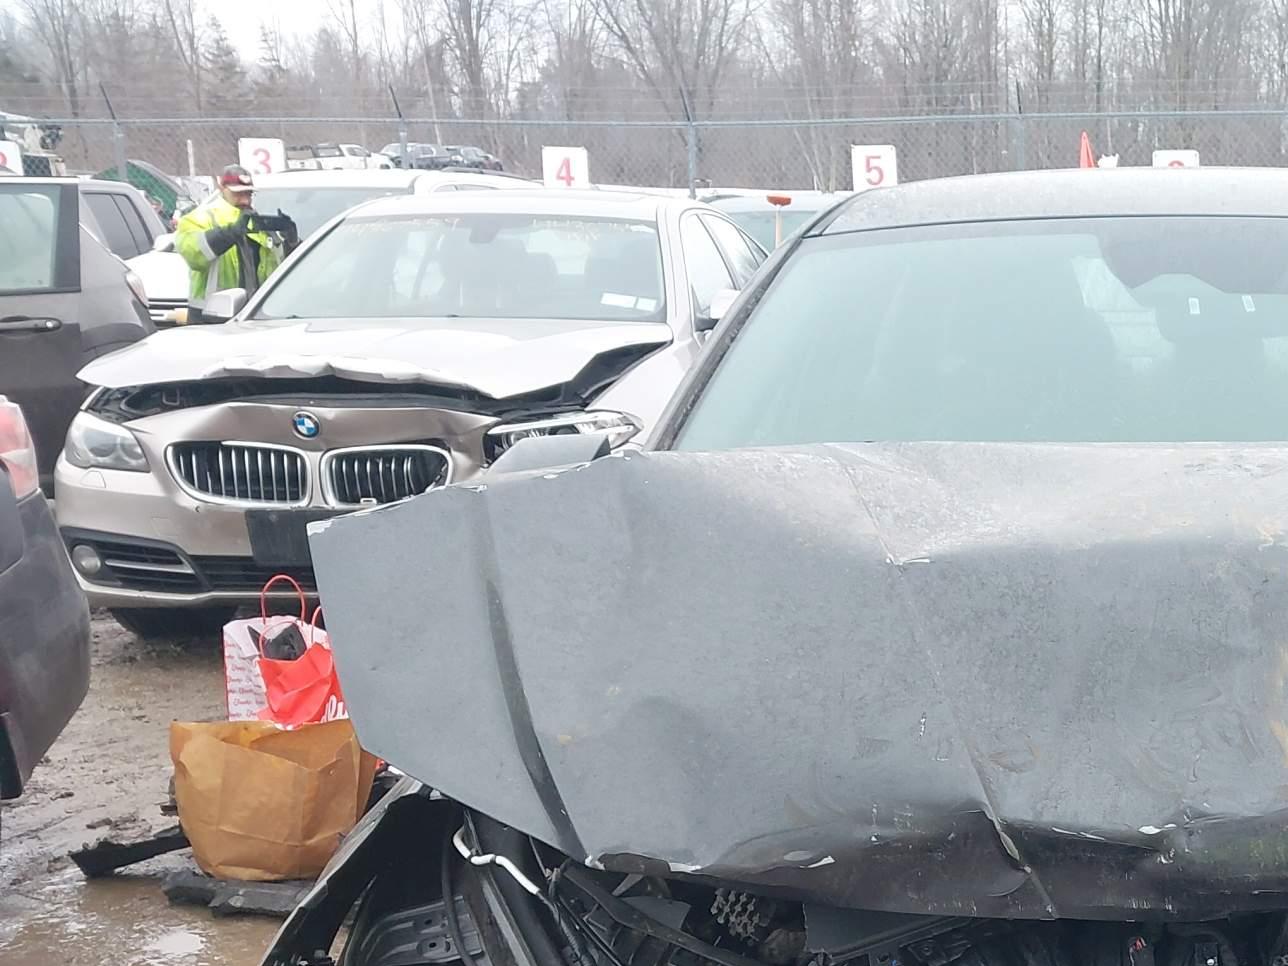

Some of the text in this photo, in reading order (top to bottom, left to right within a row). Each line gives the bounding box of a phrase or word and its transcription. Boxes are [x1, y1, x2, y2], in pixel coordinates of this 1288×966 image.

[252, 148, 272, 174] 3
[556, 157, 575, 187] 4
[865, 155, 884, 186] 5
